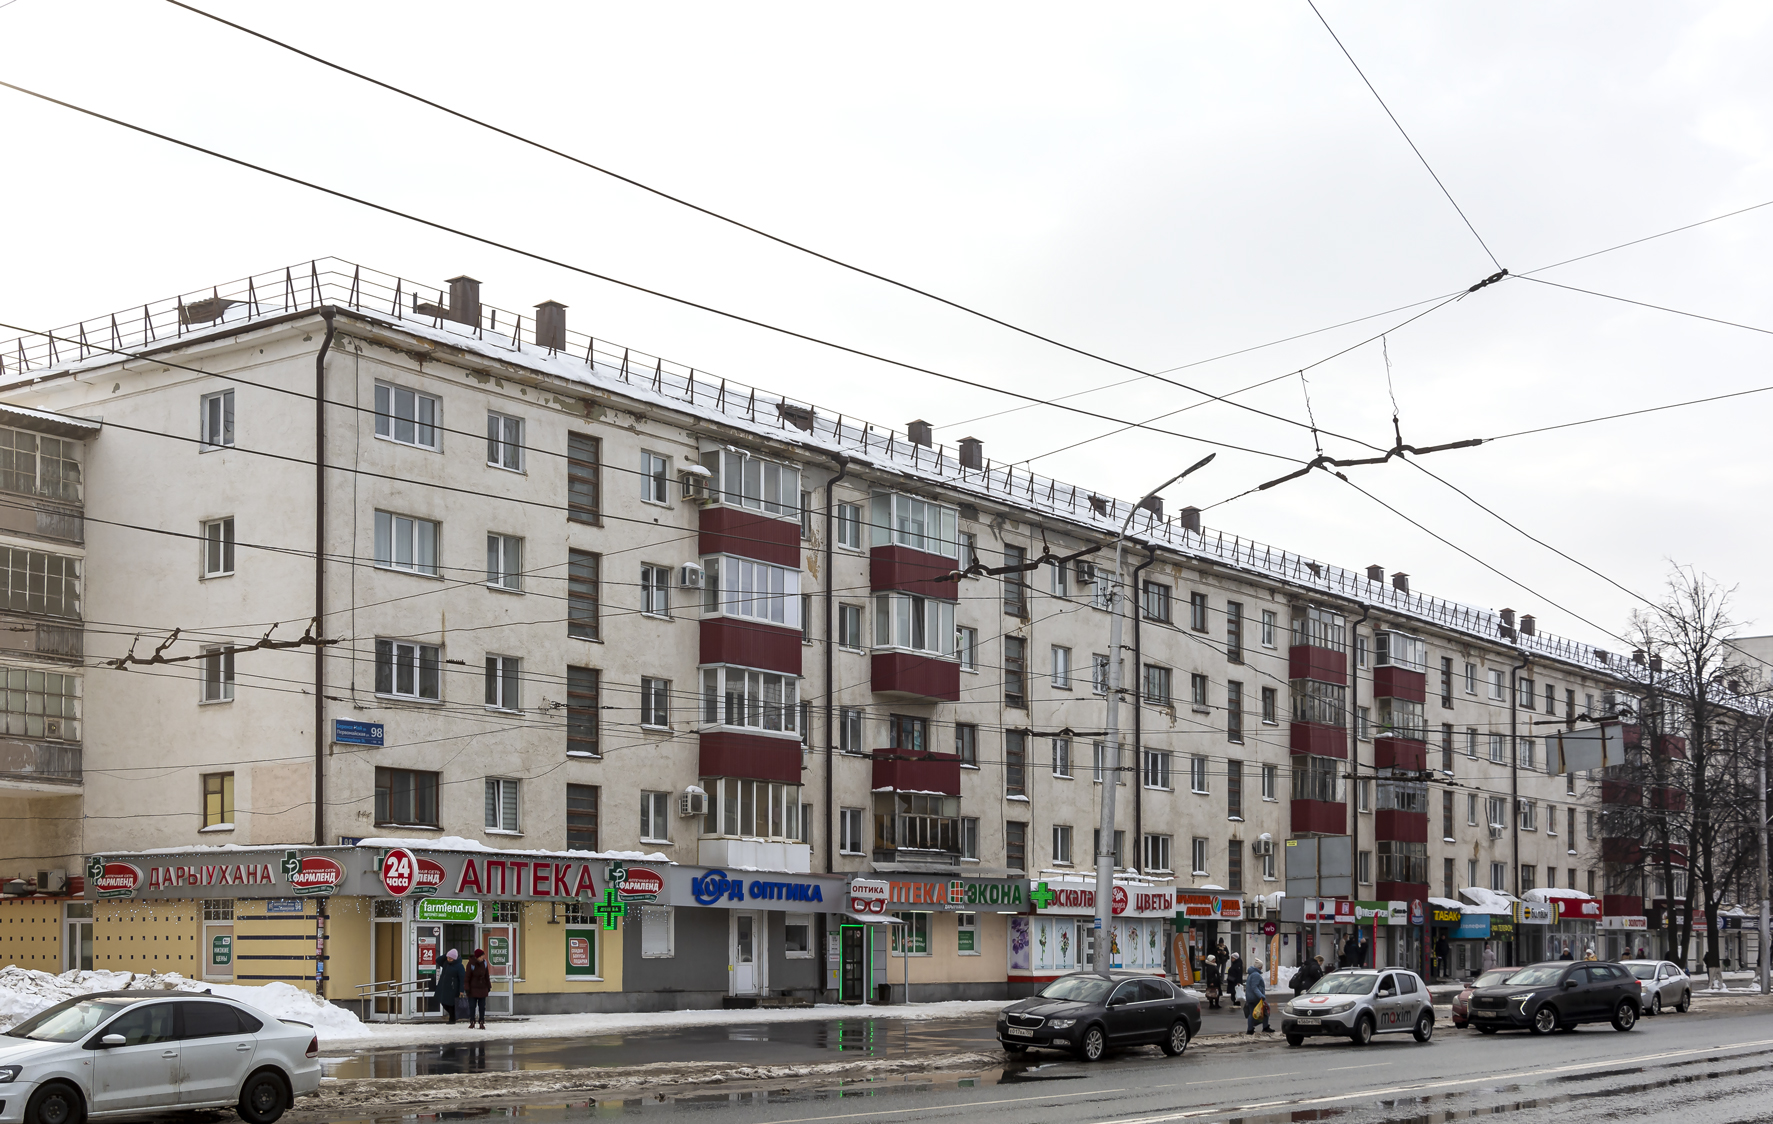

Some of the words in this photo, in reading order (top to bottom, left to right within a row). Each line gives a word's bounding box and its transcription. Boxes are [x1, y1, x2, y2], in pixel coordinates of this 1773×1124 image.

[371, 727, 382, 738] 98
[387, 856, 410, 877] 24
[98, 878, 134, 887] ФАРМЛЕНД
[148, 864, 274, 890] ДАРЫУХАНА
[293, 873, 336, 883] ФАРМЛЕНД
[387, 878, 408, 887] часа
[417, 874, 440, 884] ЛЕНД
[457, 858, 596, 898] АПТЕКА
[619, 882, 659, 892] ФАРМЛЕНД
[750, 880, 823, 902] ОПТИКА
[852, 885, 884, 894] ОПТИКА
[889, 881, 947, 903] ПТЕКА
[967, 884, 1022, 904] ЭКОНА
[1136, 894, 1172, 913] ЦВЕТЫ
[1176, 895, 1211, 905] АРЫУХАНА
[1180, 959, 1188, 981] АПТЕКА
